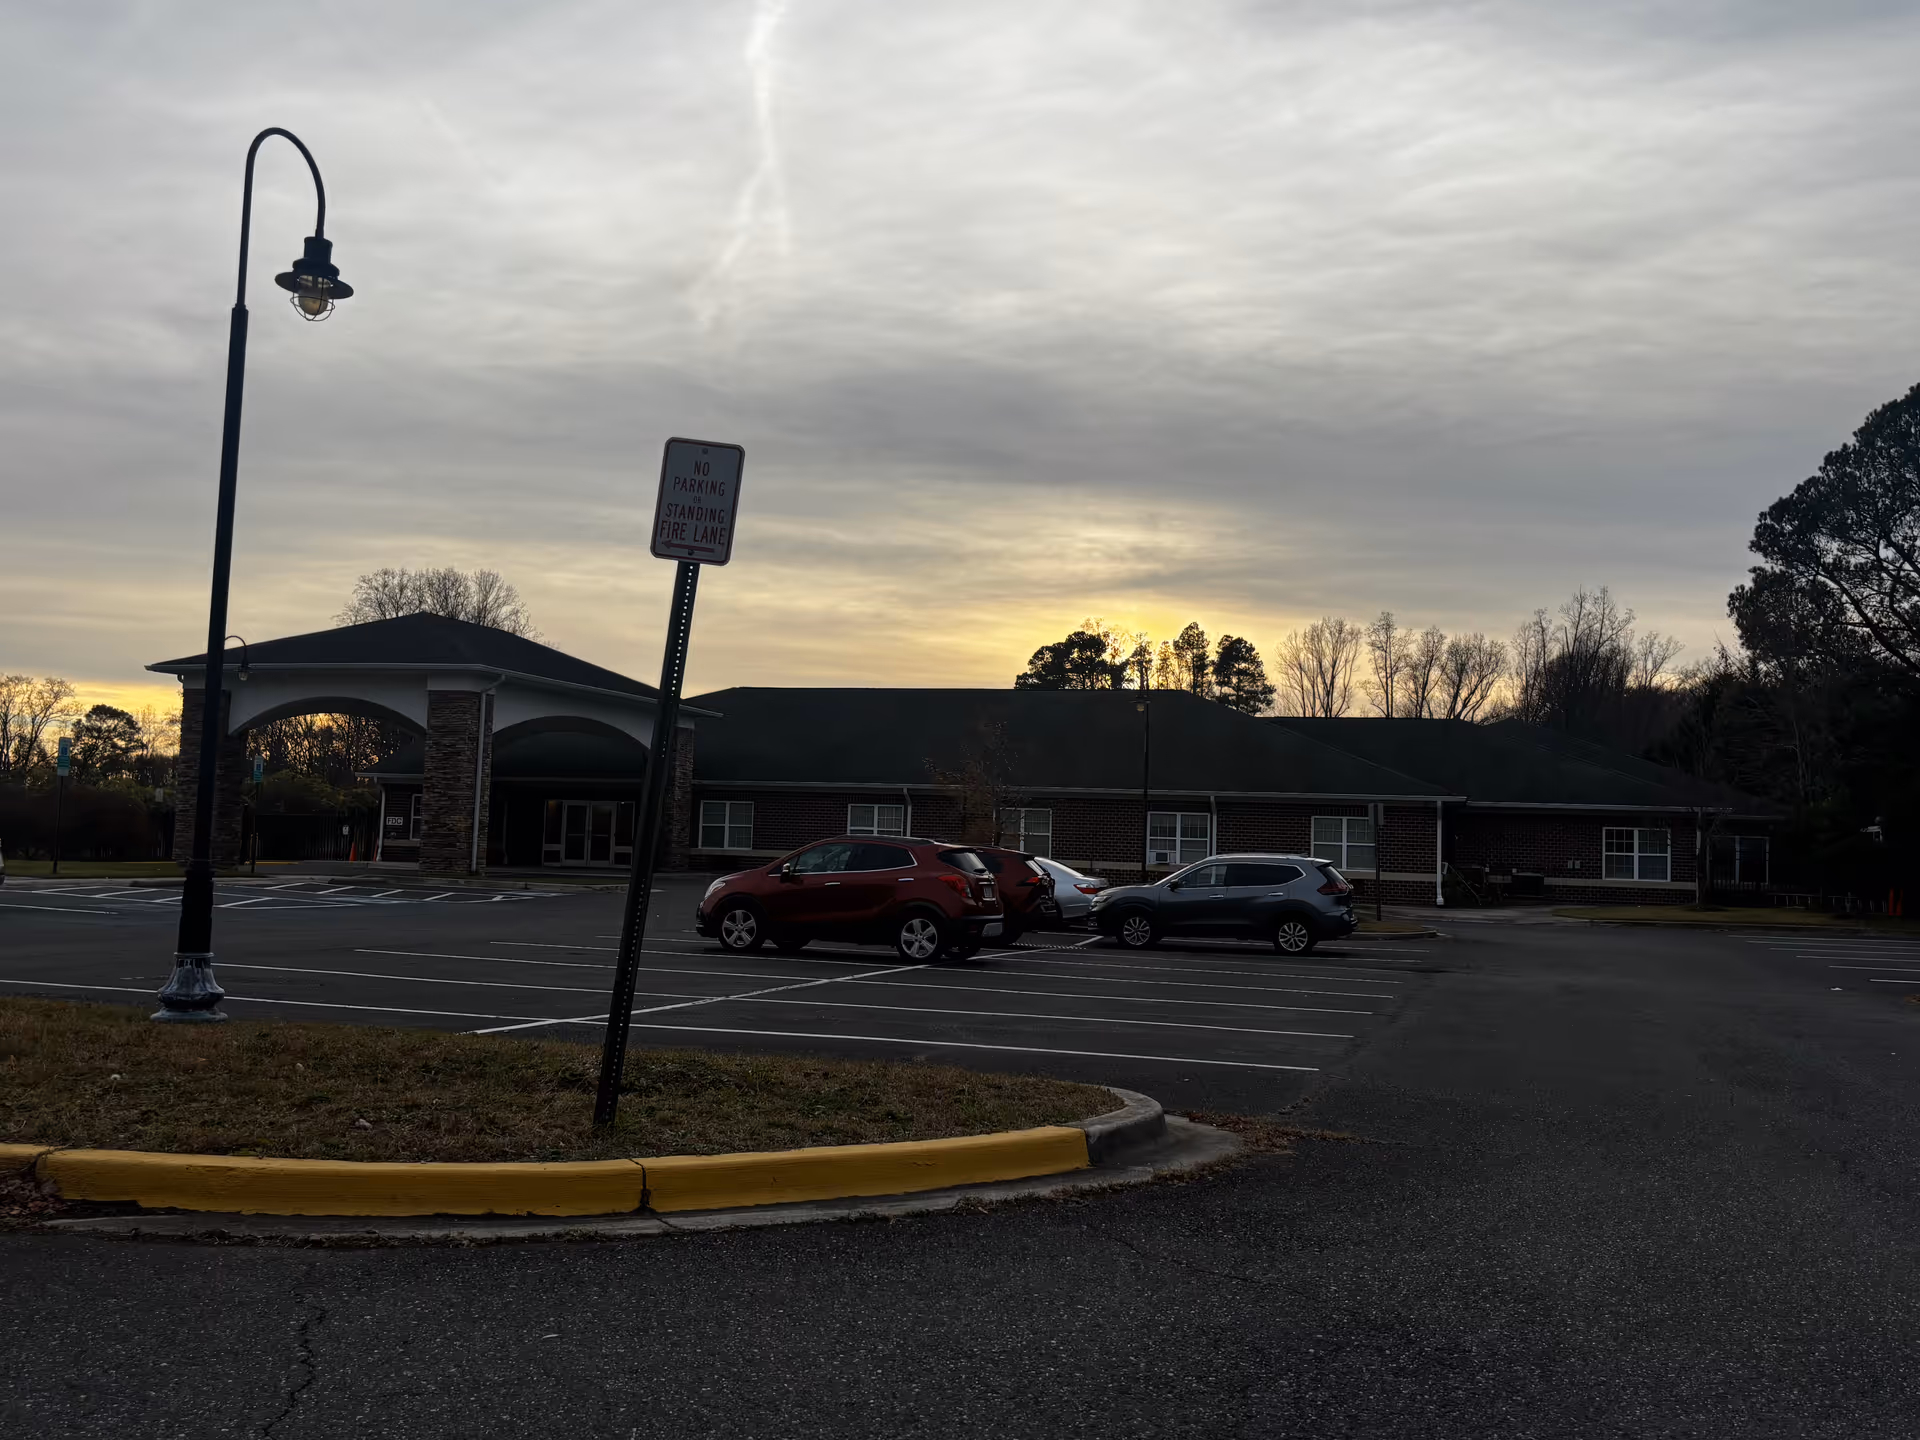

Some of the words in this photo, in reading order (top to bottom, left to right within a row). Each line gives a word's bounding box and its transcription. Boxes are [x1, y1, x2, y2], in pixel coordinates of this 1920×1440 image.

[694, 460, 710, 476] NO
[673, 477, 726, 496] PARKING
[693, 496, 702, 504] OR
[665, 503, 725, 524] STANDING
[660, 520, 687, 541] FIRE
[693, 524, 726, 545] LANE
